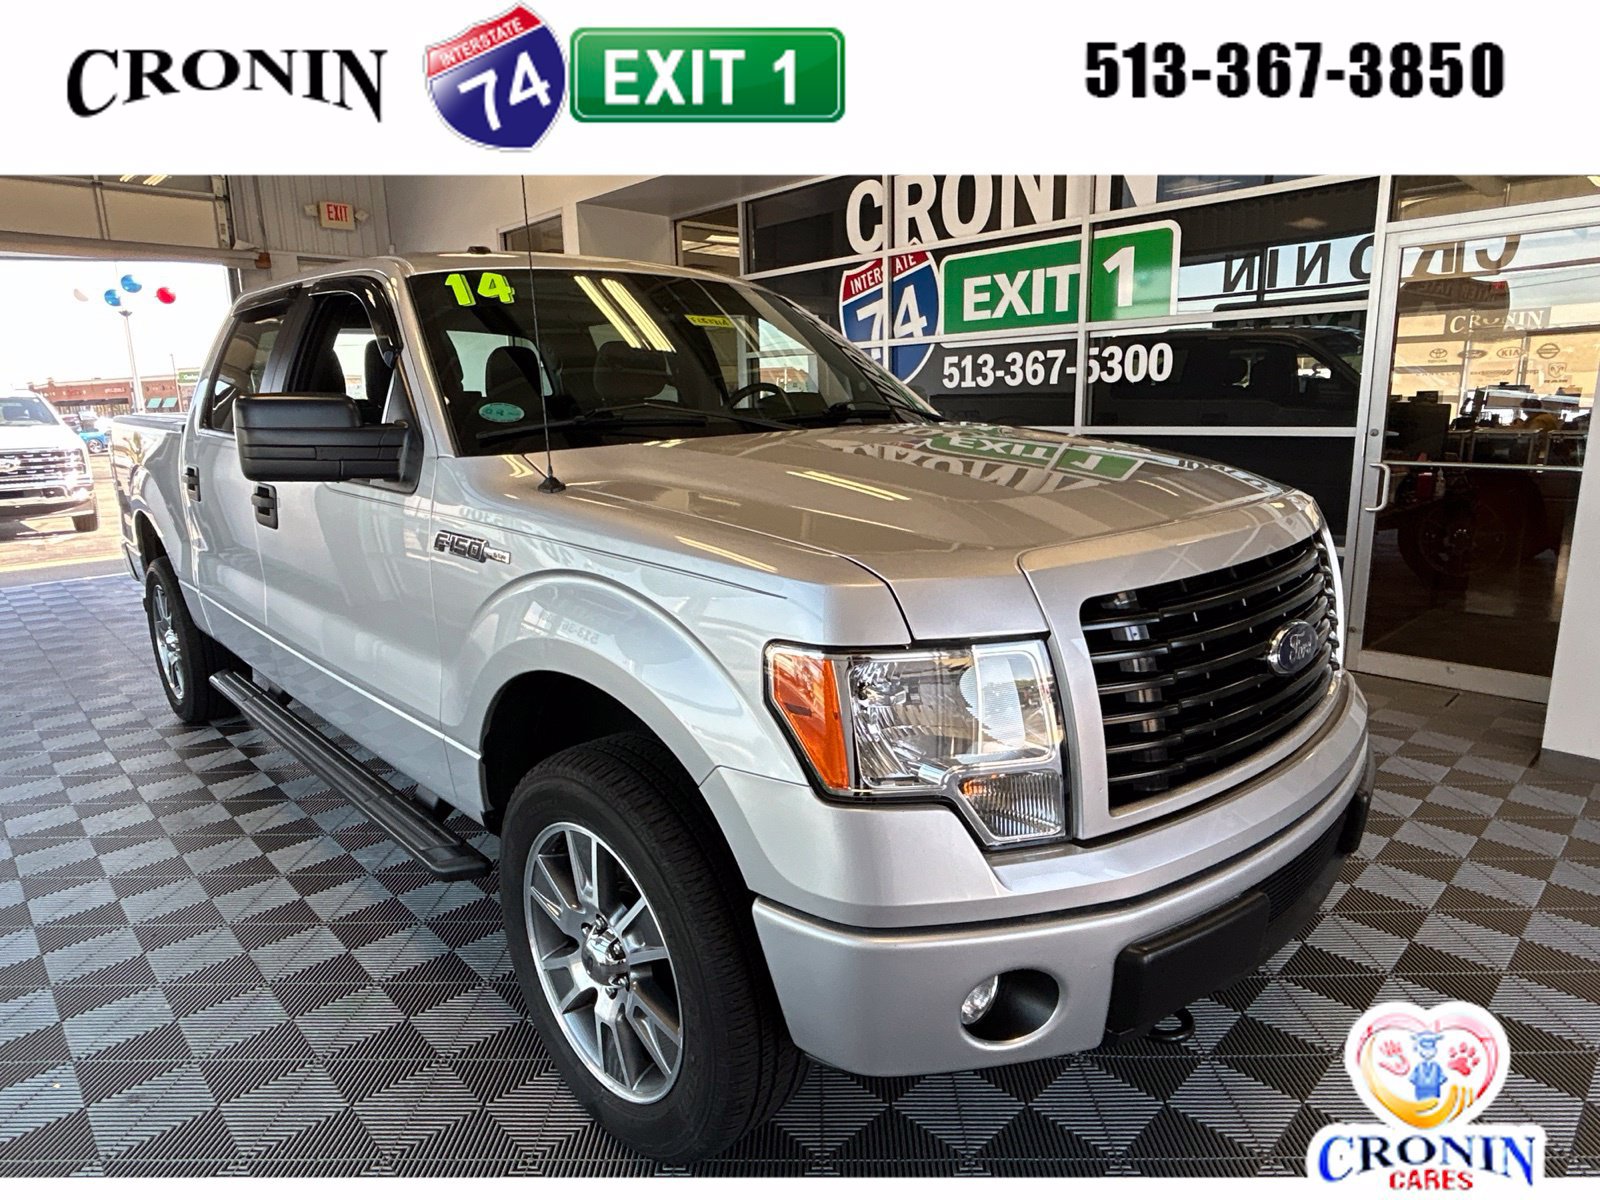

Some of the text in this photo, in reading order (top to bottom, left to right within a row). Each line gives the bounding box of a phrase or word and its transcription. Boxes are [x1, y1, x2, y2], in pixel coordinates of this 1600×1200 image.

[326, 204, 348, 222] EXIT
[846, 175, 1157, 255] CRONIN
[445, 272, 515, 306] 14
[850, 254, 917, 295] INTERATE
[963, 246, 1135, 321] EXIT 1
[856, 284, 928, 361] 74
[942, 343, 1174, 389] 513-367-5300
